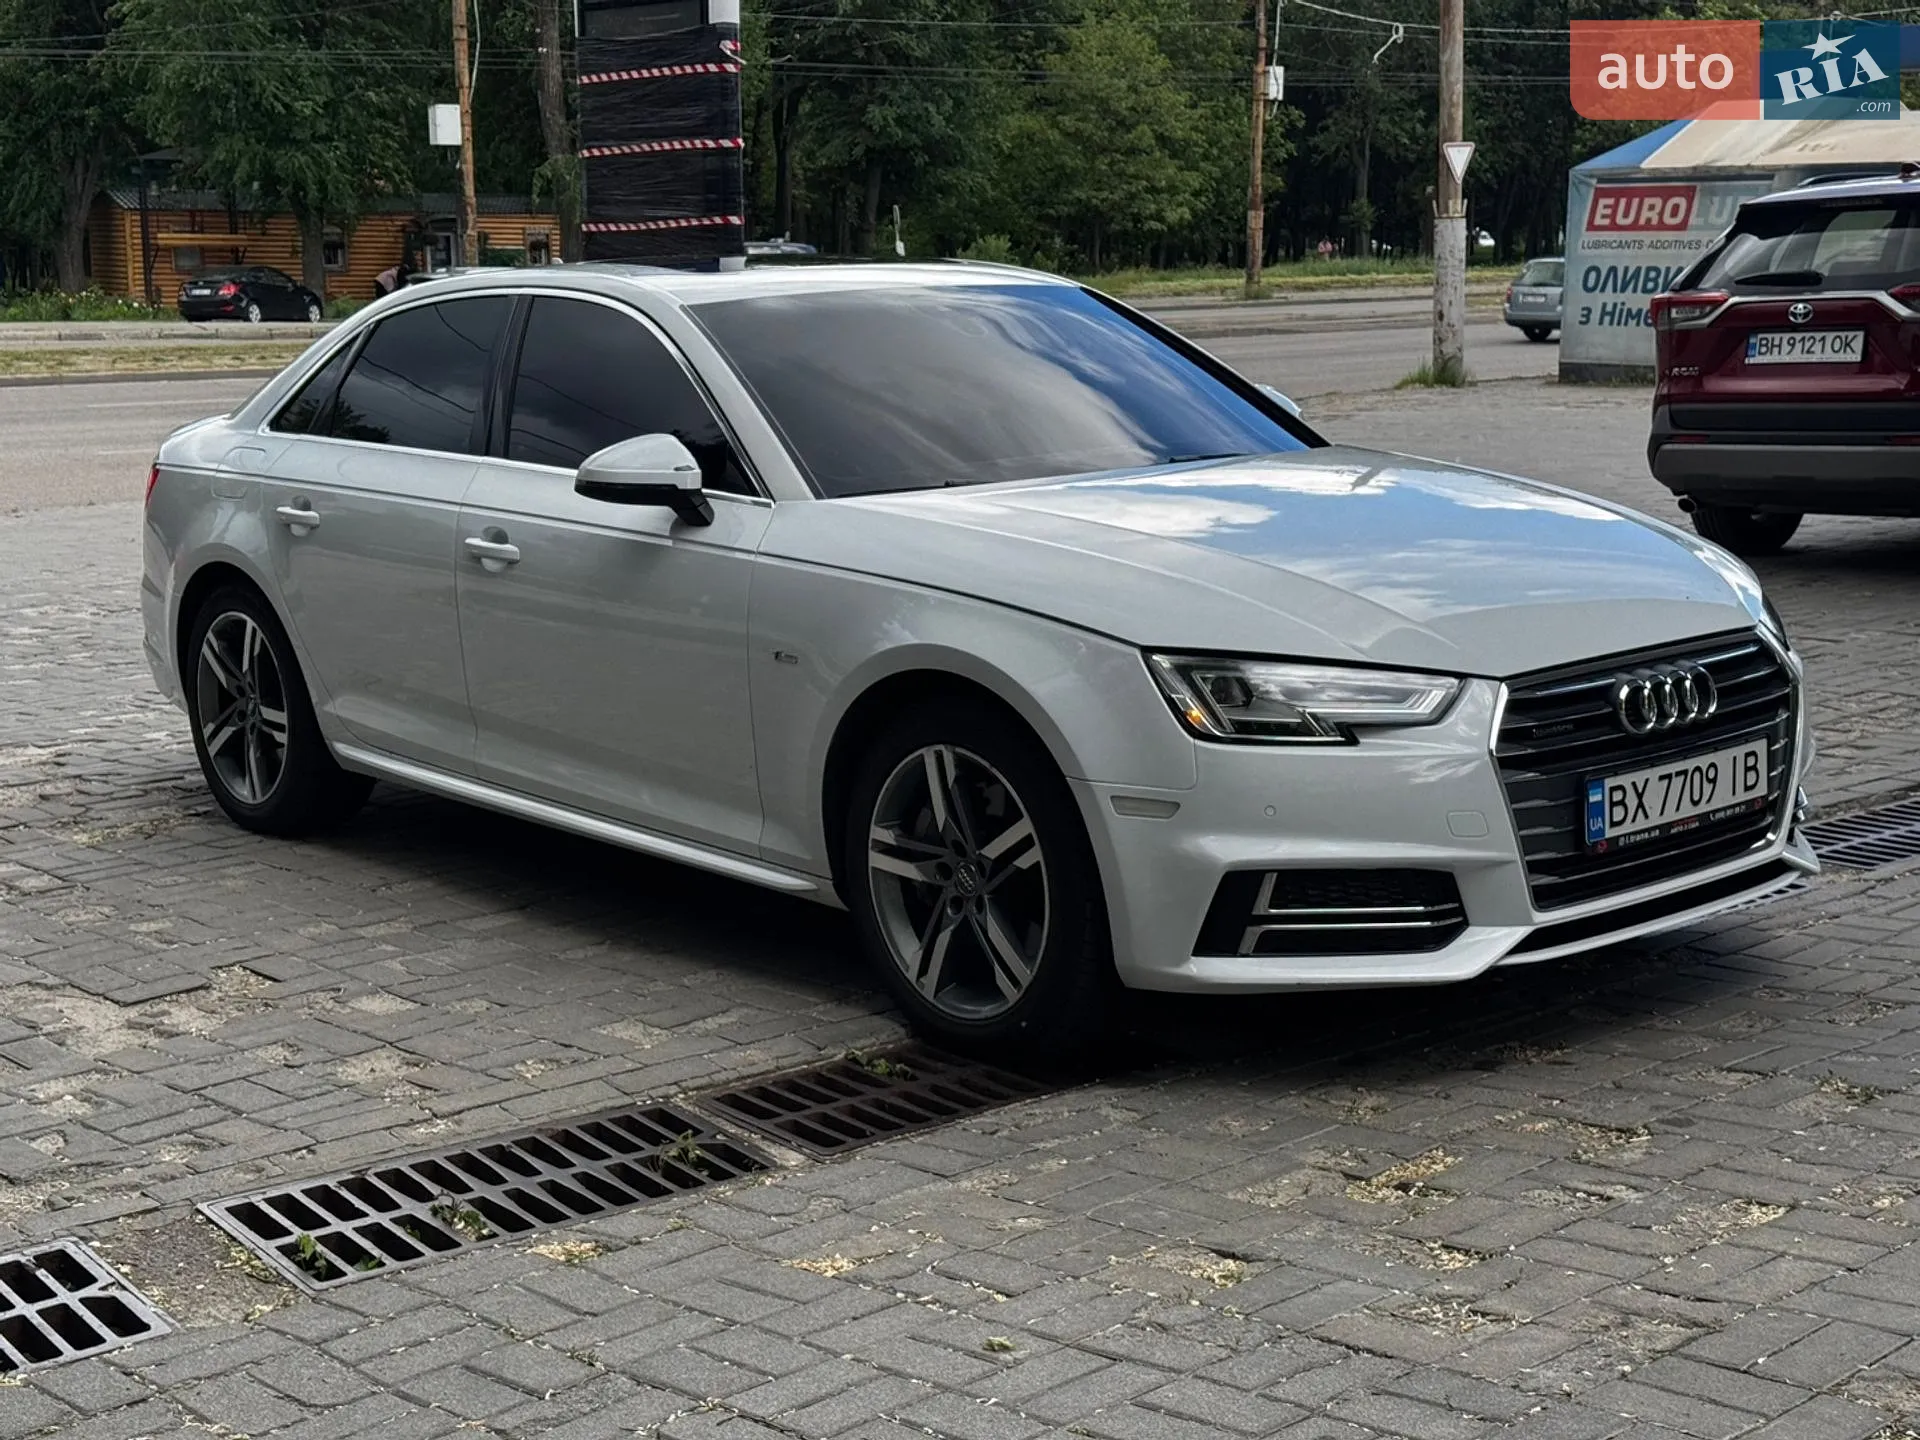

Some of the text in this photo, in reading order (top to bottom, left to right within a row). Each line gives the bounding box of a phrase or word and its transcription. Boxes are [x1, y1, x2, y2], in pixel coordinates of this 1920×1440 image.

[1578, 306, 1592, 326] з
[1758, 334, 1858, 355] BH 9121 OK
[1609, 750, 1760, 828] BX 7709 IB
[1590, 817, 1604, 831] UA
